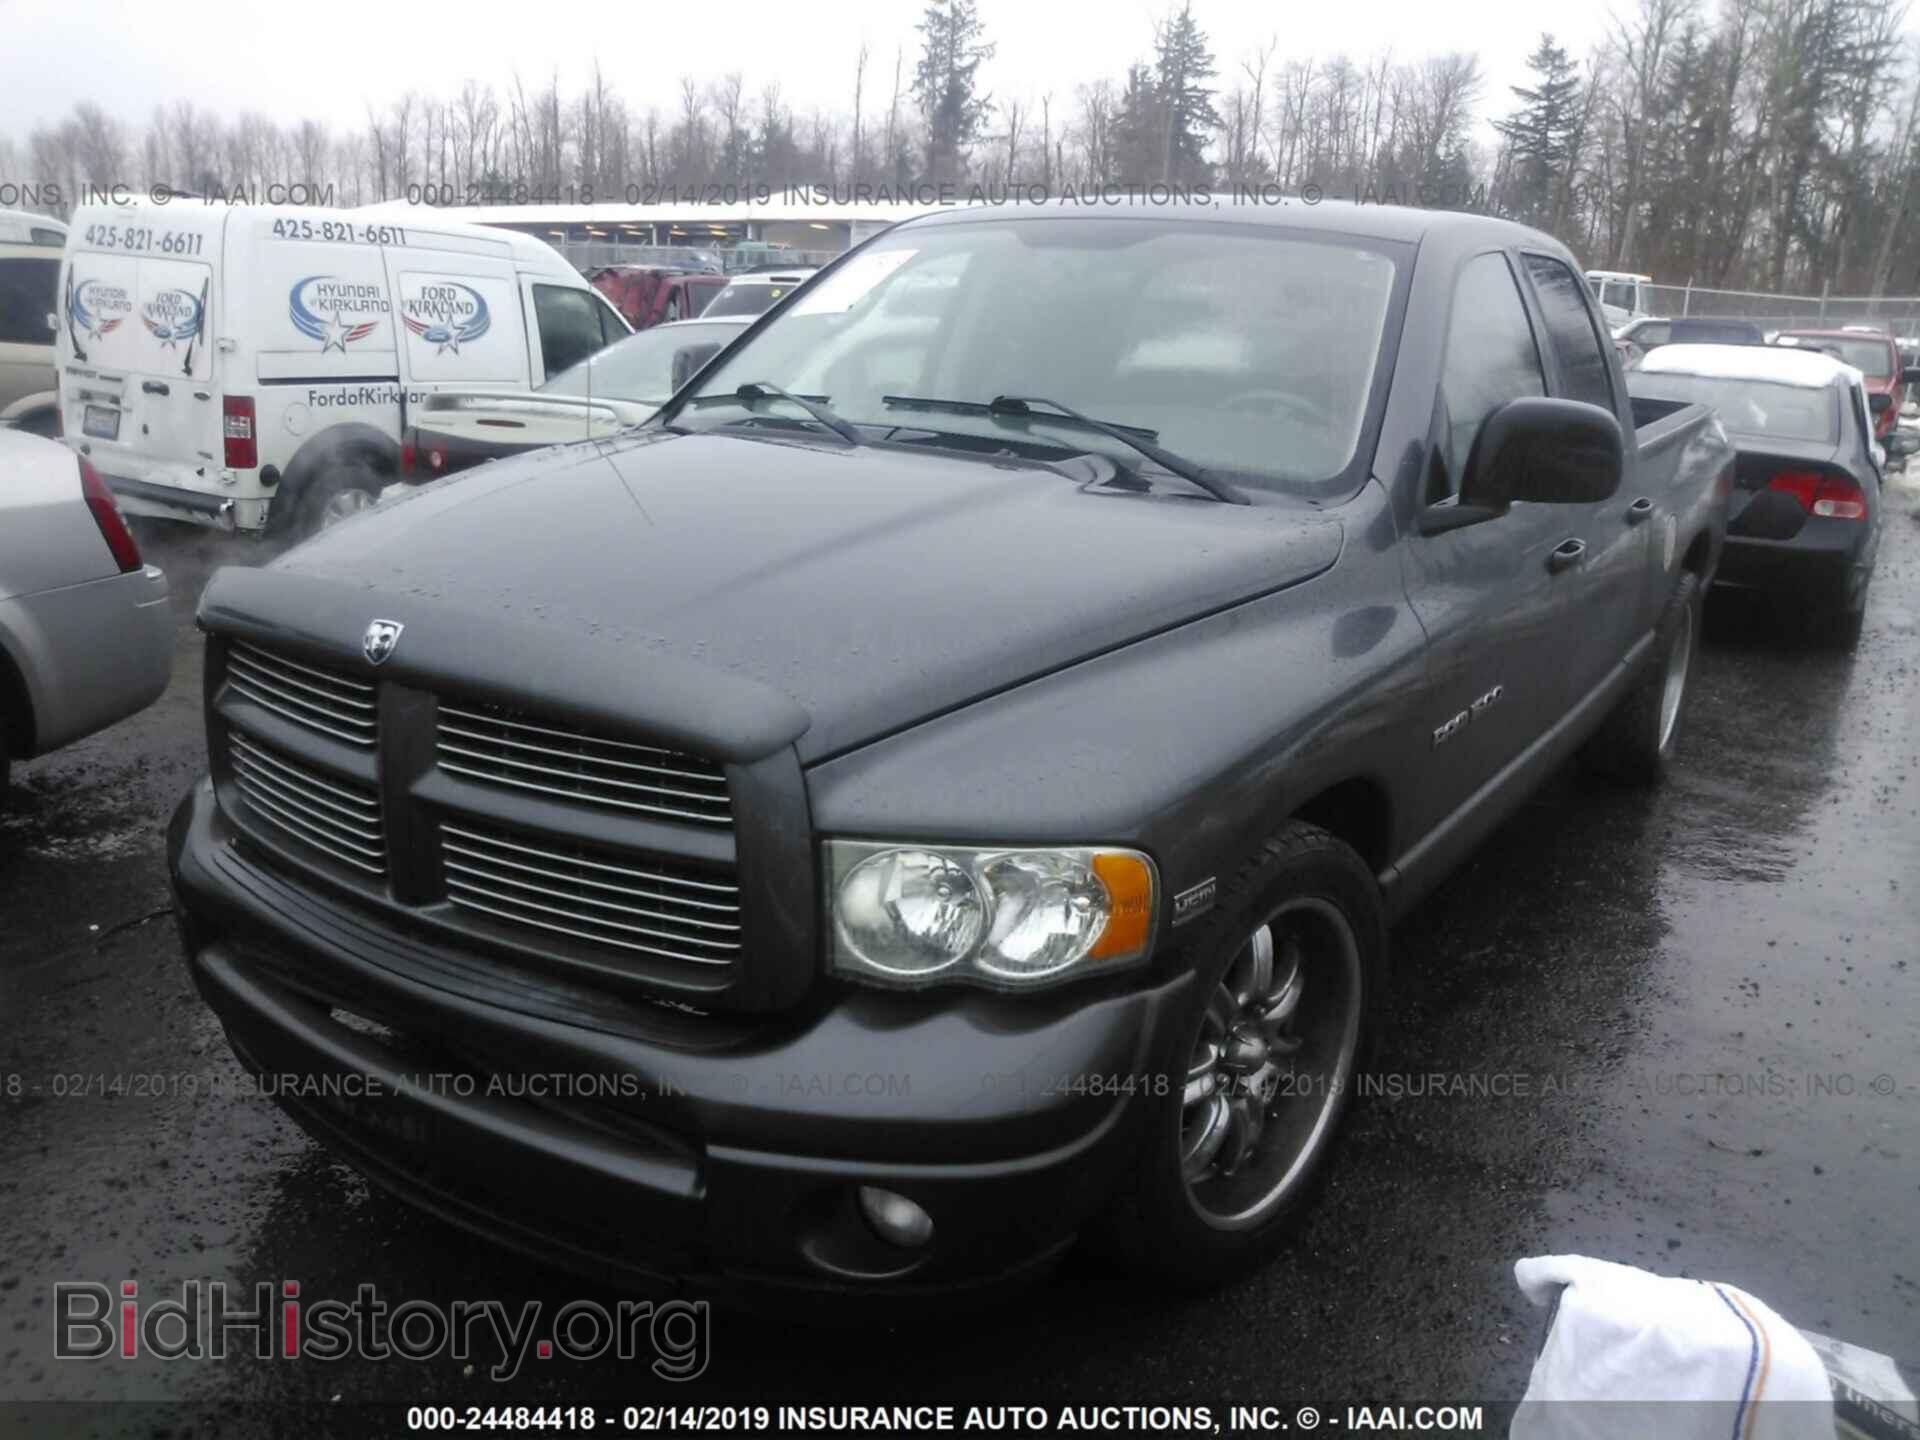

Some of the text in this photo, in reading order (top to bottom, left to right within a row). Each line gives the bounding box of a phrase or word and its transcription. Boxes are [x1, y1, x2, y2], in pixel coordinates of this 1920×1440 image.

[85, 225, 203, 254] 425-821-6611
[273, 218, 407, 245] 425-821-6611
[316, 284, 380, 299] HYUNDAI
[421, 286, 456, 301] FORD
[318, 299, 392, 313] KIRKLAND
[408, 300, 474, 321] KIRKLAND
